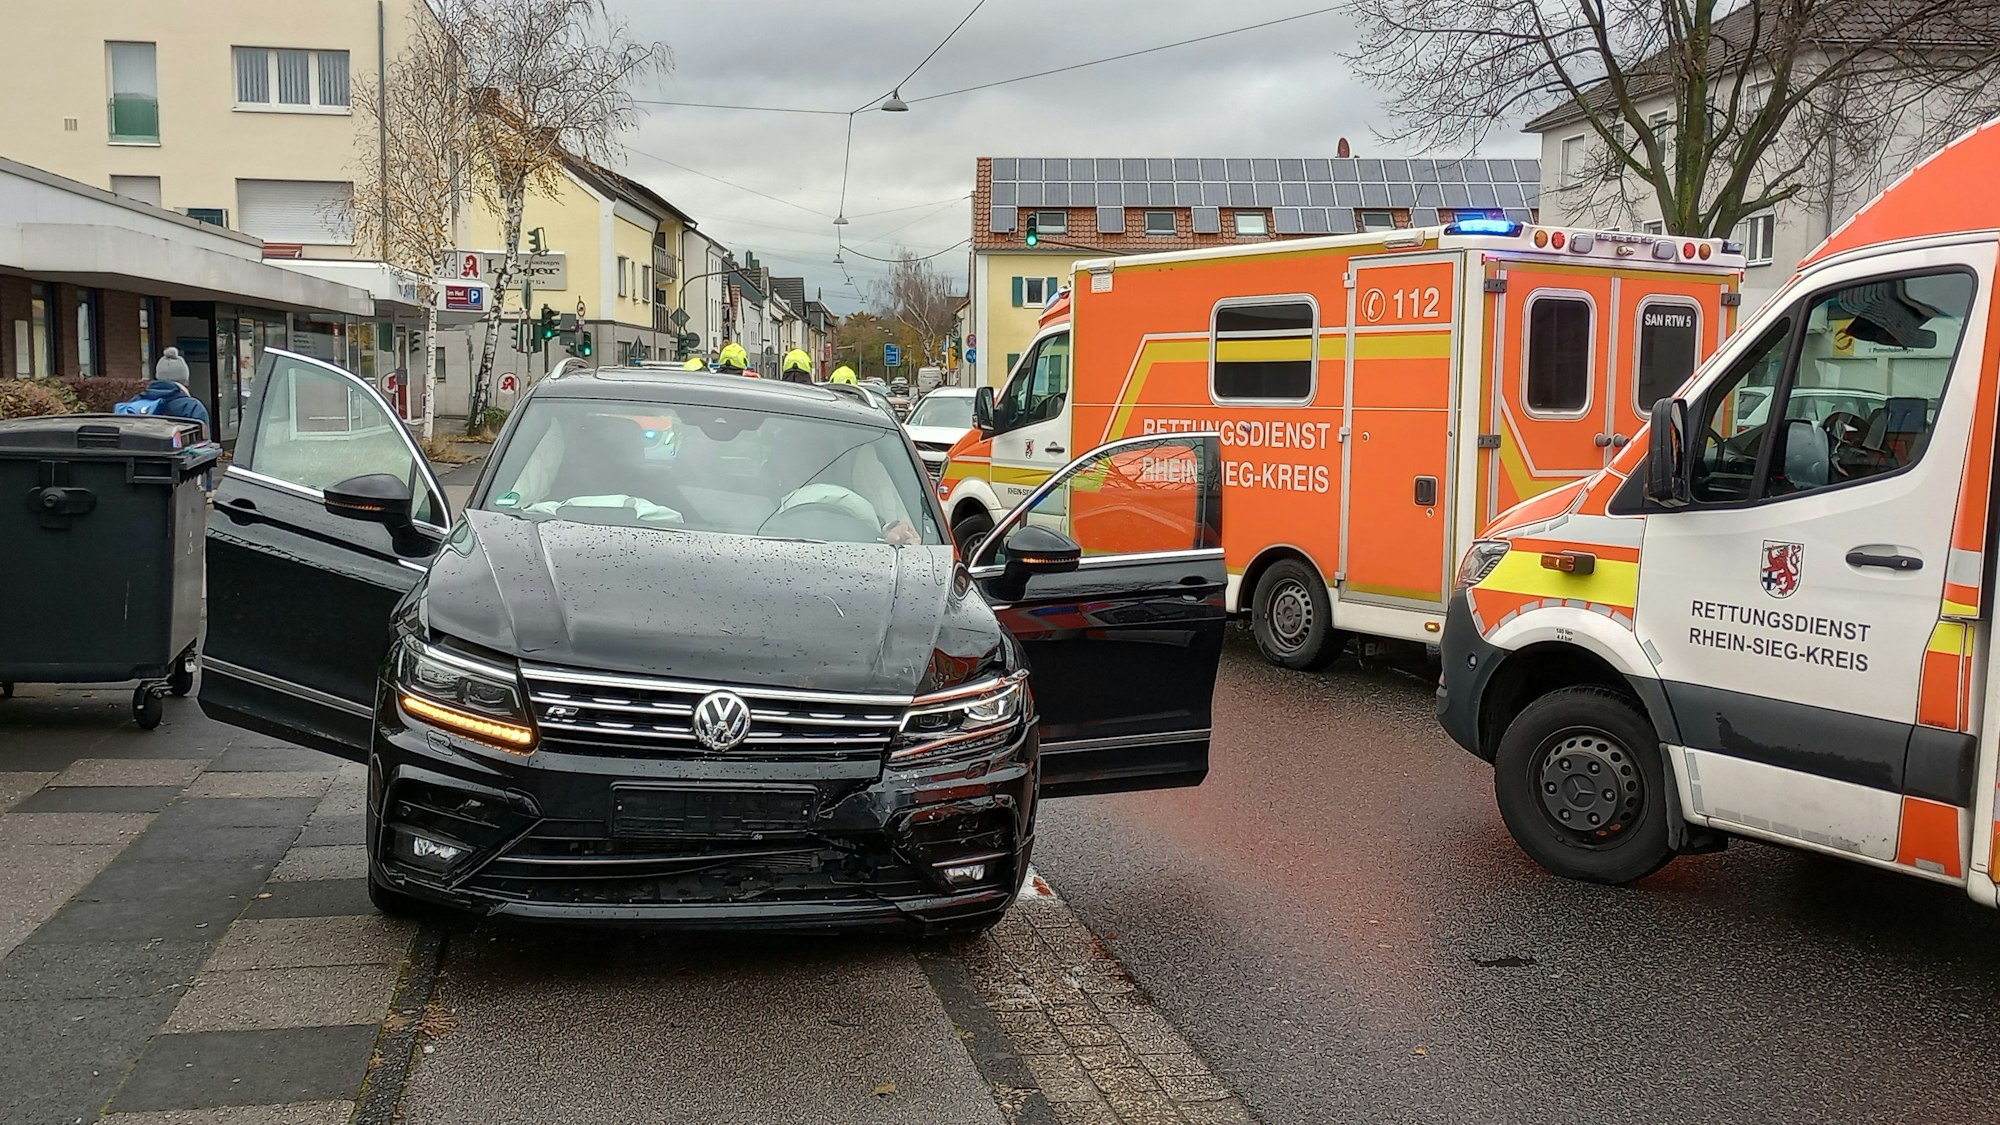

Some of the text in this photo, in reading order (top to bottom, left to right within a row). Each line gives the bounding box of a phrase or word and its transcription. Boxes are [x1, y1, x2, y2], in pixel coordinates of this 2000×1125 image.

[471, 290, 479, 302] P
[1393, 287, 1440, 319] 112
[1645, 313, 1692, 328] SAN RTW 5
[1142, 457, 1330, 493] RHEINIEG-KREIS
[1691, 600, 1871, 642] RETTUNGSDIENST
[1689, 627, 1869, 672] RHEIN-SIEG-KREIS
